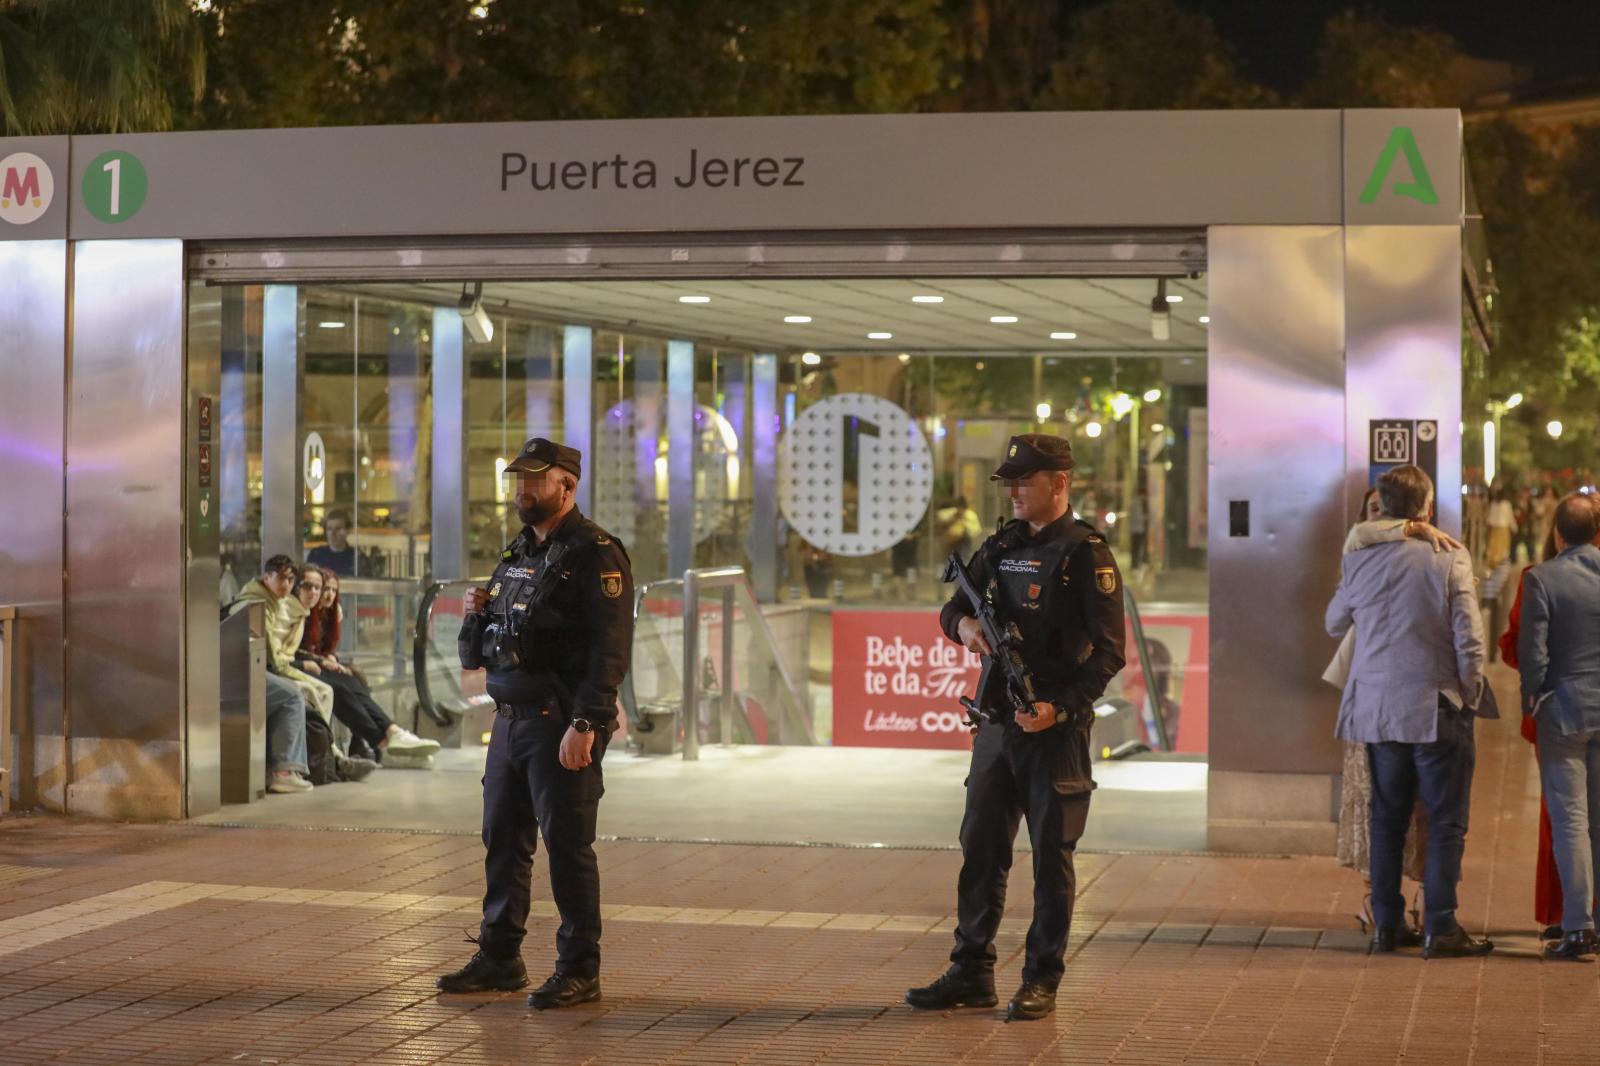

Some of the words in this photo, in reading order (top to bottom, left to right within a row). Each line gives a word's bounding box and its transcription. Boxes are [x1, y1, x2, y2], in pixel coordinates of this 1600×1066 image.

[501, 152, 657, 191] Puerta
[674, 148, 805, 189] Jerez
[103, 158, 121, 216] 1
[998, 565, 1039, 573] NACIONAL
[866, 635, 923, 667] Bebe
[928, 636, 957, 668] de
[865, 669, 887, 695] te
[921, 710, 977, 732] COV
